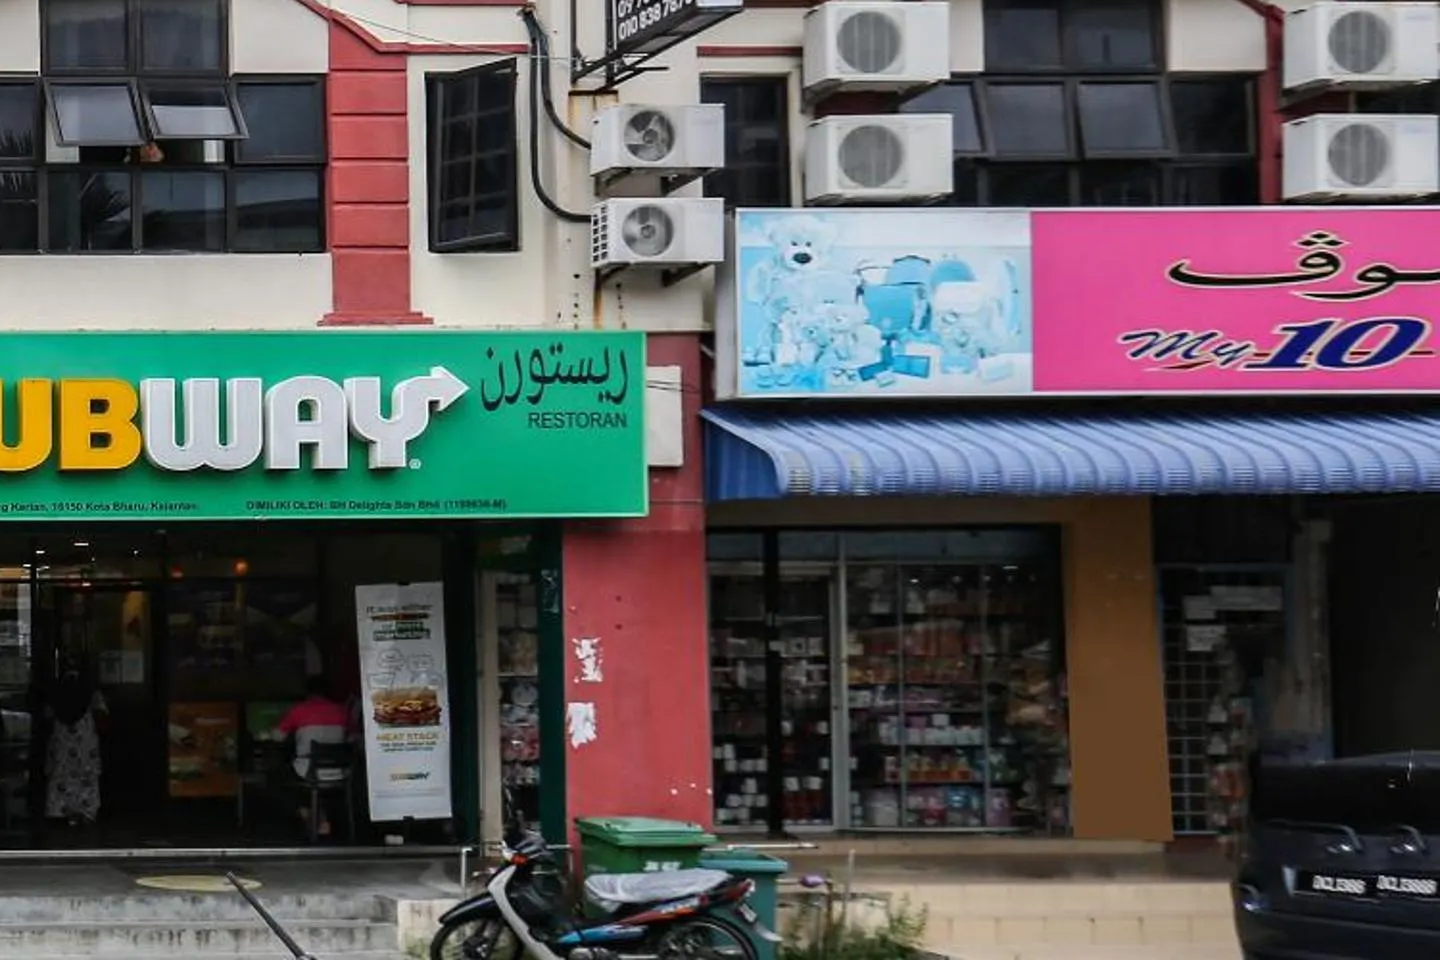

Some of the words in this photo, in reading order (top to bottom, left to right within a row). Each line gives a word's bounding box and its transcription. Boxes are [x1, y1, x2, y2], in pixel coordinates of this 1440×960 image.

[617, 15, 638, 41] 010
[639, 4, 661, 30] 838
[527, 412, 628, 429] RESTORAN
